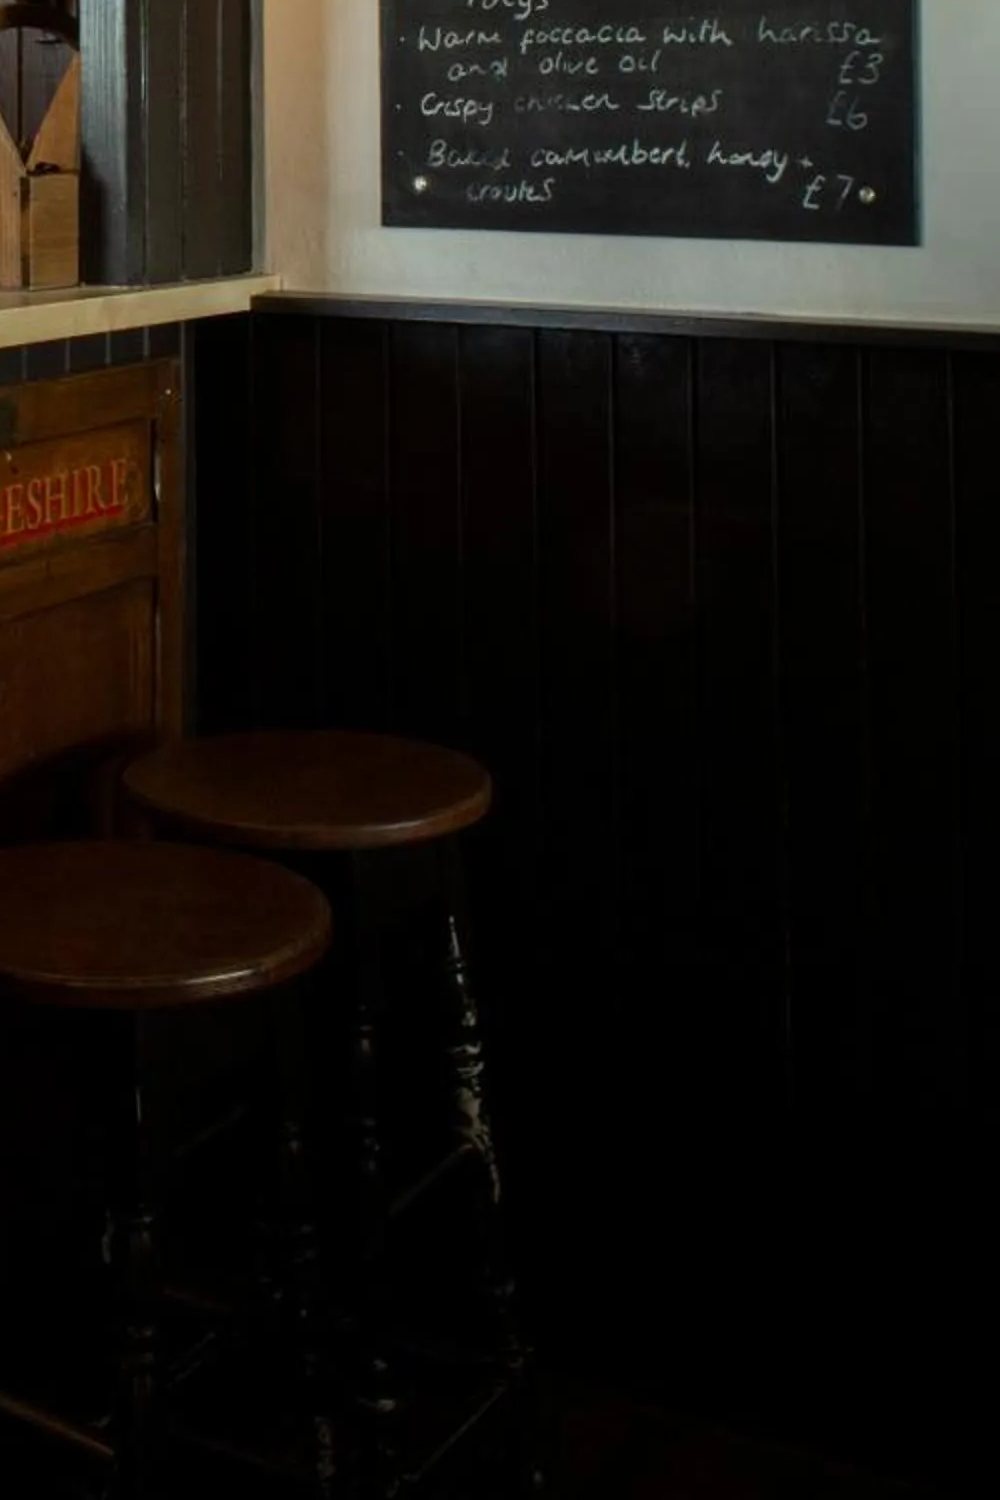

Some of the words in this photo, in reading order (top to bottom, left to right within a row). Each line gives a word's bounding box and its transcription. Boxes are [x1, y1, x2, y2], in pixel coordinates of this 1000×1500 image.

[417, 24, 502, 51] Warm
[662, 16, 735, 47] with
[447, 57, 509, 81] and
[539, 51, 600, 75] olive
[838, 50, 885, 85] £3
[420, 92, 494, 125] Crispy
[825, 90, 868, 131] £6
[706, 140, 788, 184] honey
[801, 173, 856, 210] £7
